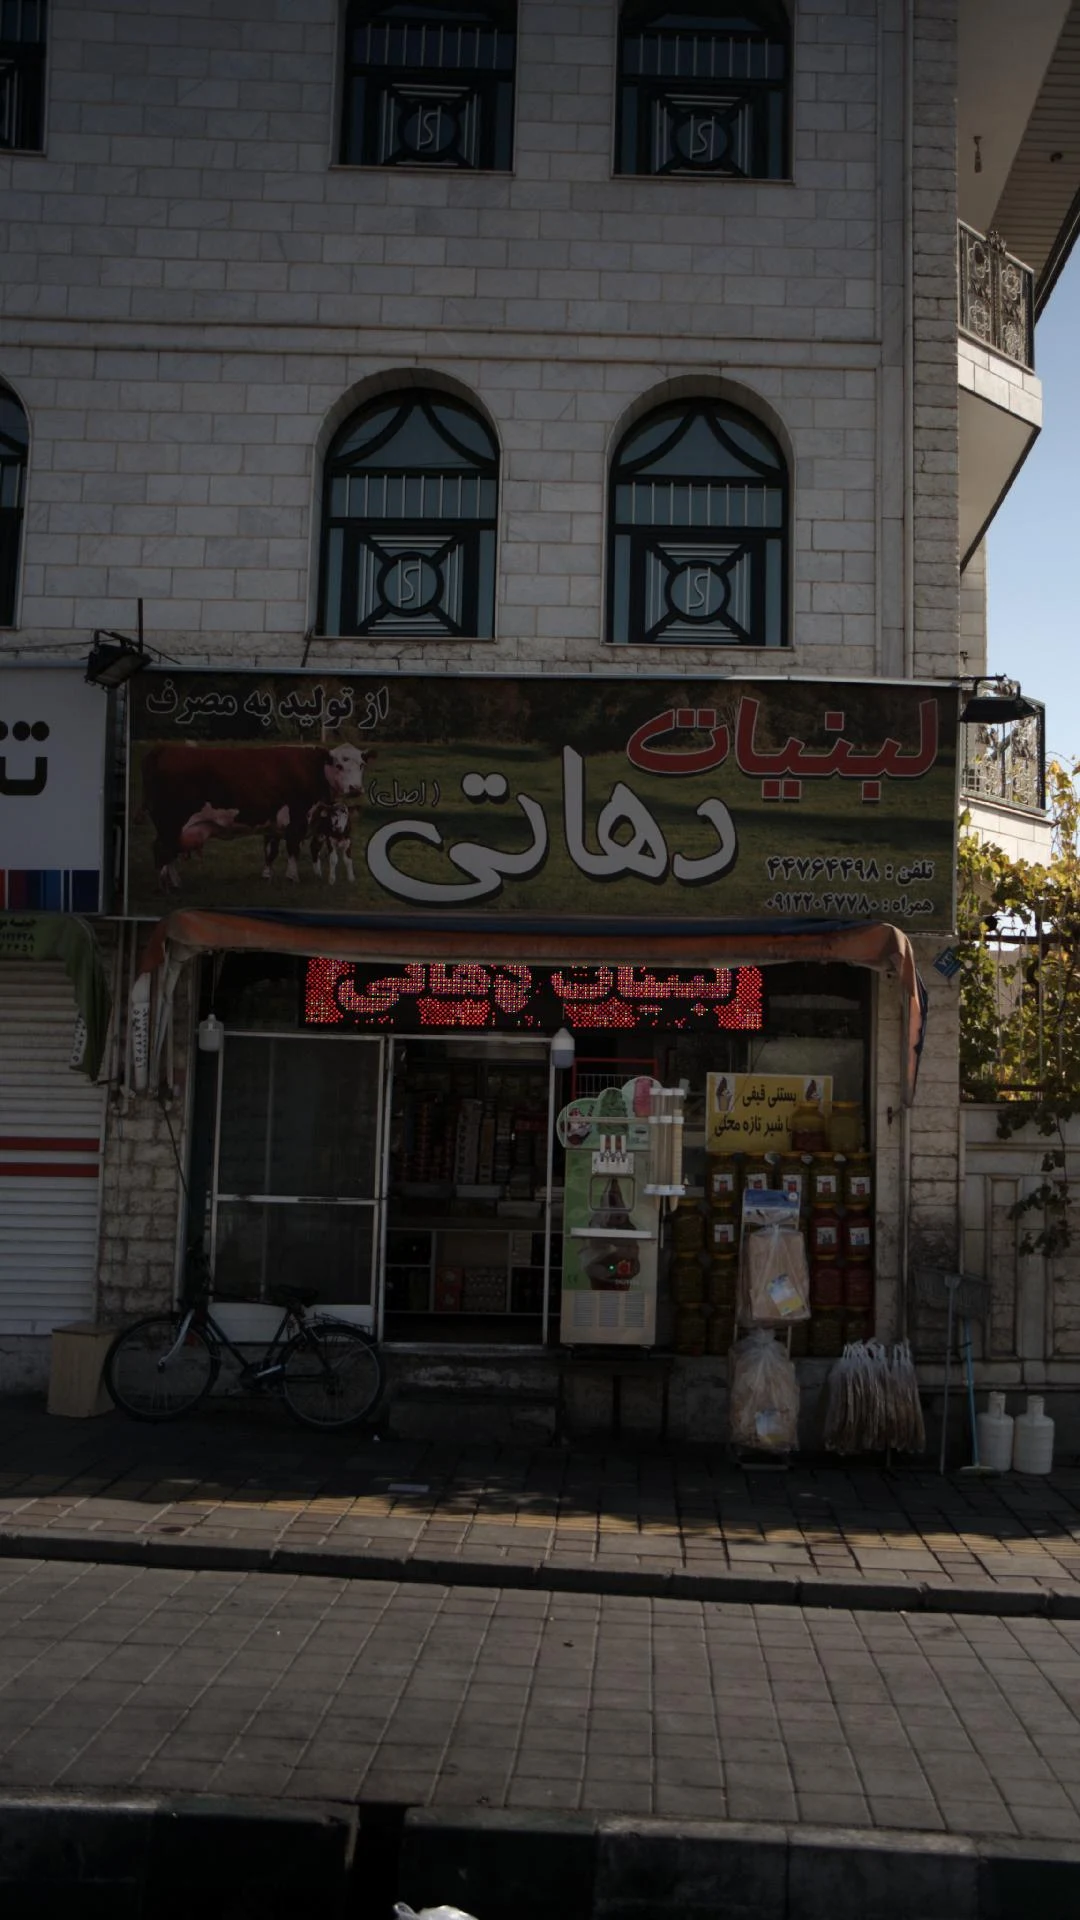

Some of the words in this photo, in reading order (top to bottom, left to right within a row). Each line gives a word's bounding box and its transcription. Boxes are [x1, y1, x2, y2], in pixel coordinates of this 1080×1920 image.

[145, 678, 239, 725] مصرف
[243, 689, 273, 727] به
[278, 684, 355, 729] تولید
[358, 686, 390, 729] از
[626, 696, 939, 803] لبنیات
[366, 744, 740, 907] دهاتی
[766, 856, 879, 881] ۴۴۷۶۴۴۹۸
[767, 1086, 797, 1108] بستنی
